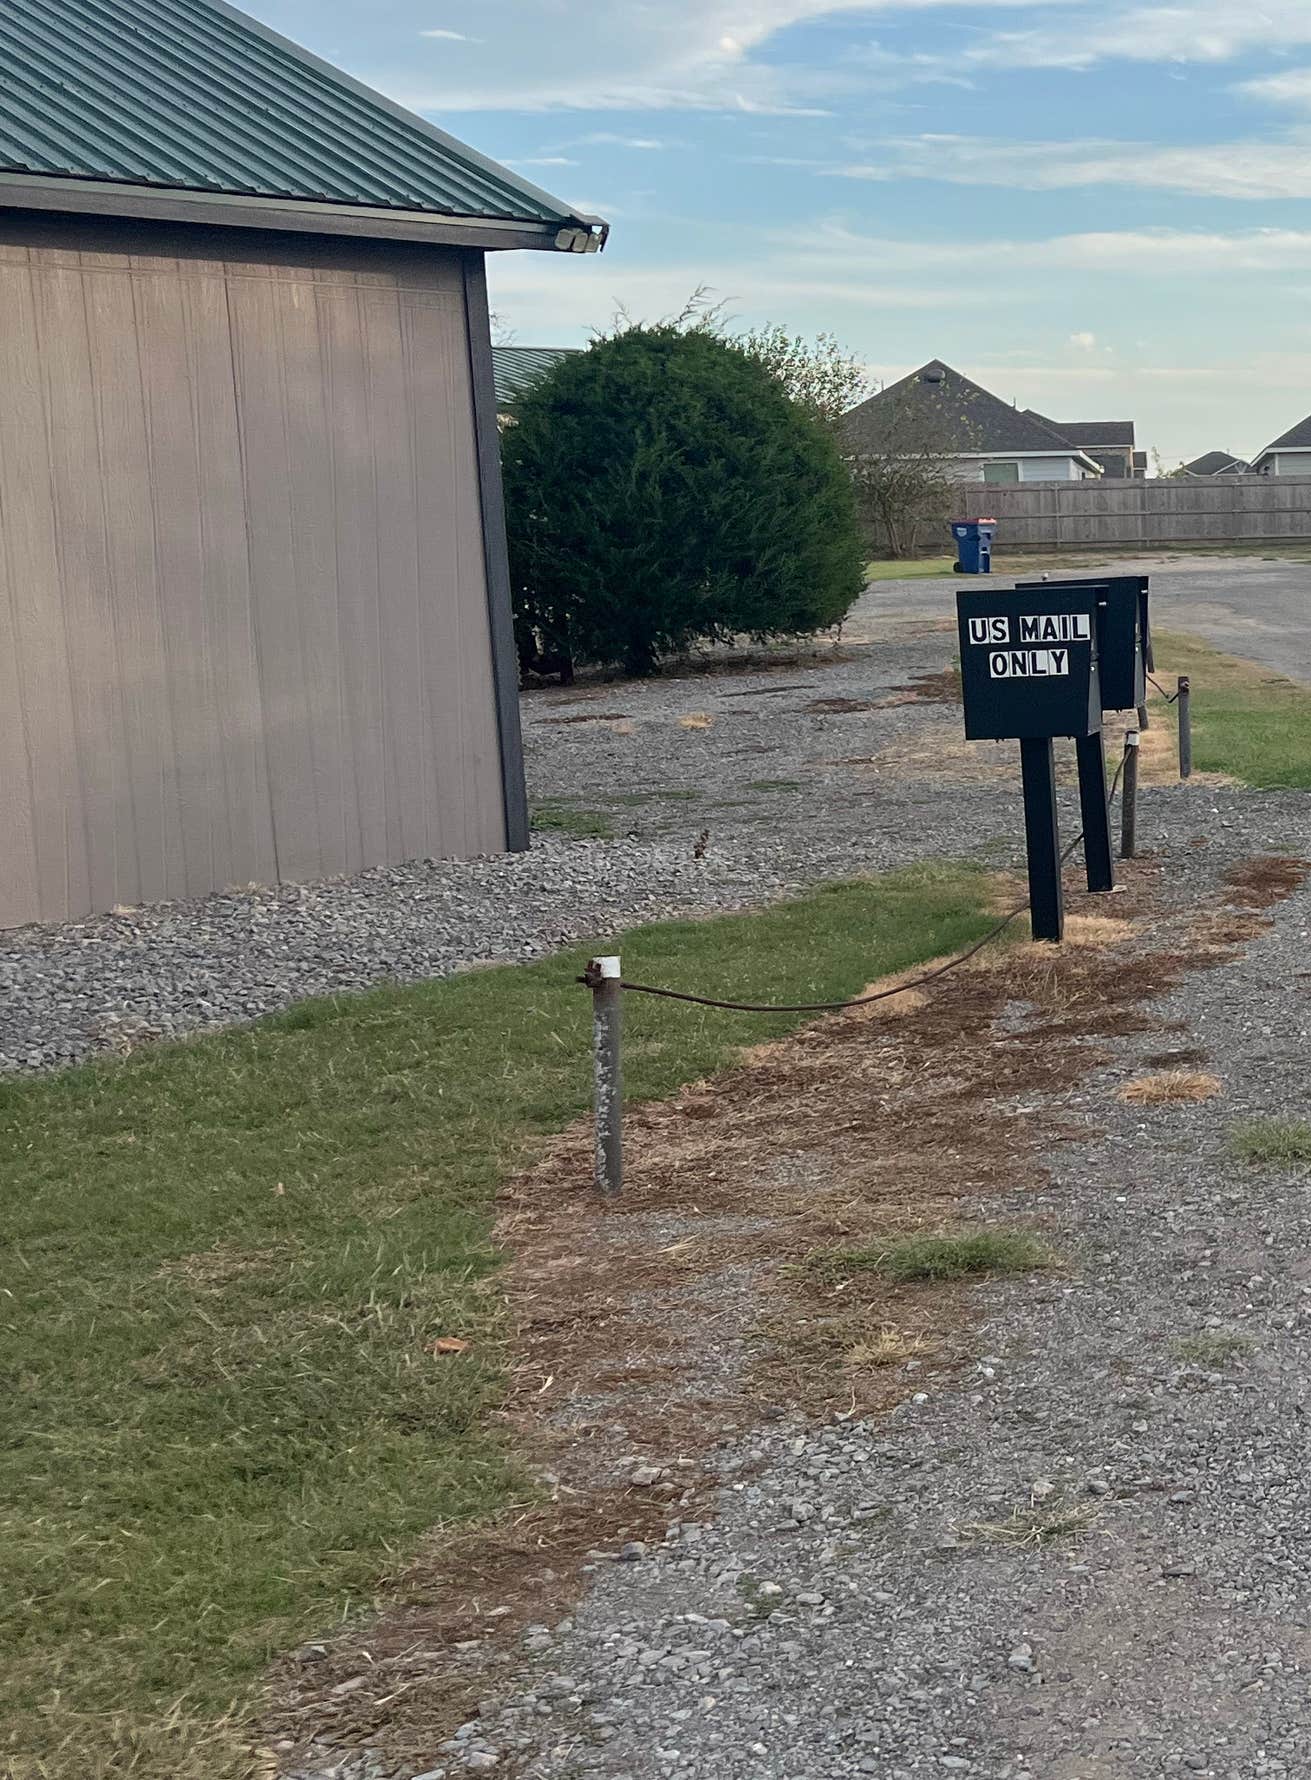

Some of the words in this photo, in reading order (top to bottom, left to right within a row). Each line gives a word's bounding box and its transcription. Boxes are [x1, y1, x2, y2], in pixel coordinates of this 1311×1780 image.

[970, 618, 1007, 642] US
[1020, 615, 1088, 641] MAIL
[991, 650, 1066, 676] ONLY
